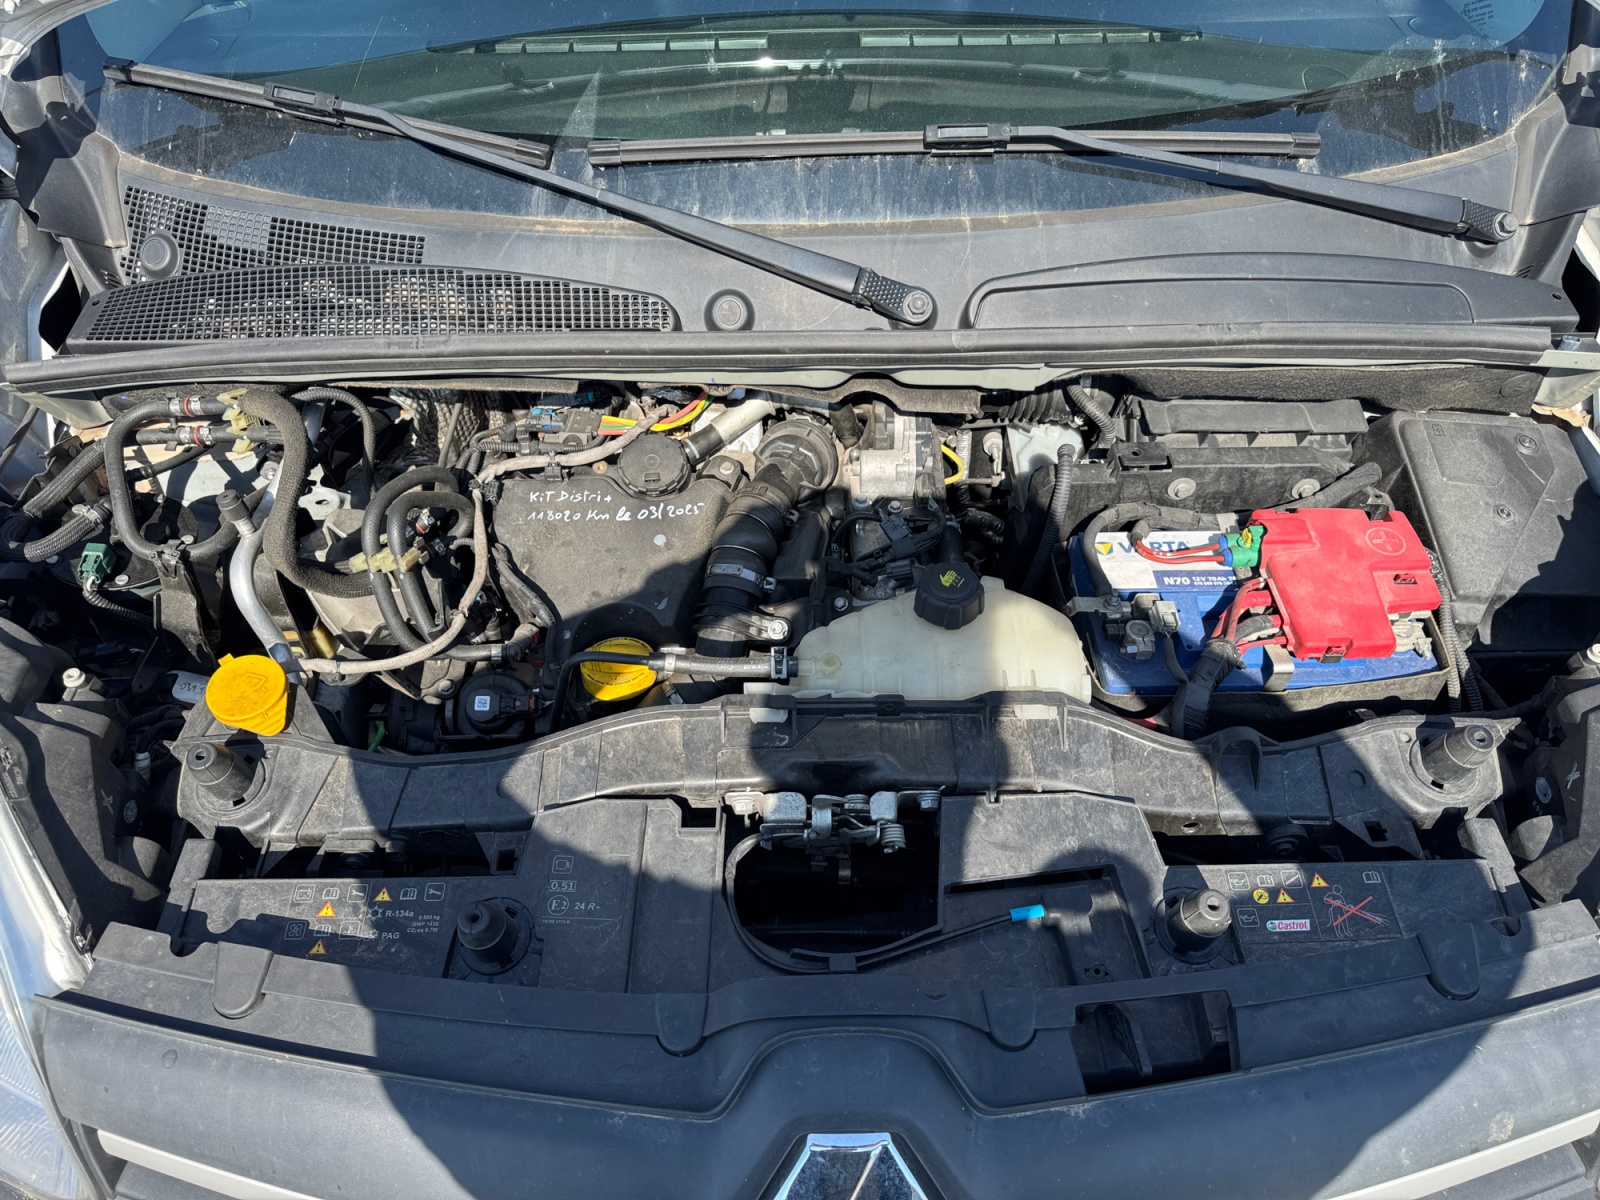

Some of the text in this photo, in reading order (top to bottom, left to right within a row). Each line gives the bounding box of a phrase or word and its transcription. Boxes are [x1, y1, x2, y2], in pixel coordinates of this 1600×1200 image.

[528, 510, 581, 522] 118020
[637, 502, 705, 520] 03/2025
[1117, 541, 1191, 553] VRTA
[1163, 576, 1190, 585] N70
[574, 901, 586, 910] 24
[385, 909, 415, 918] R-134a
[1277, 921, 1308, 931] Castrol
[381, 931, 400, 940] PAG
